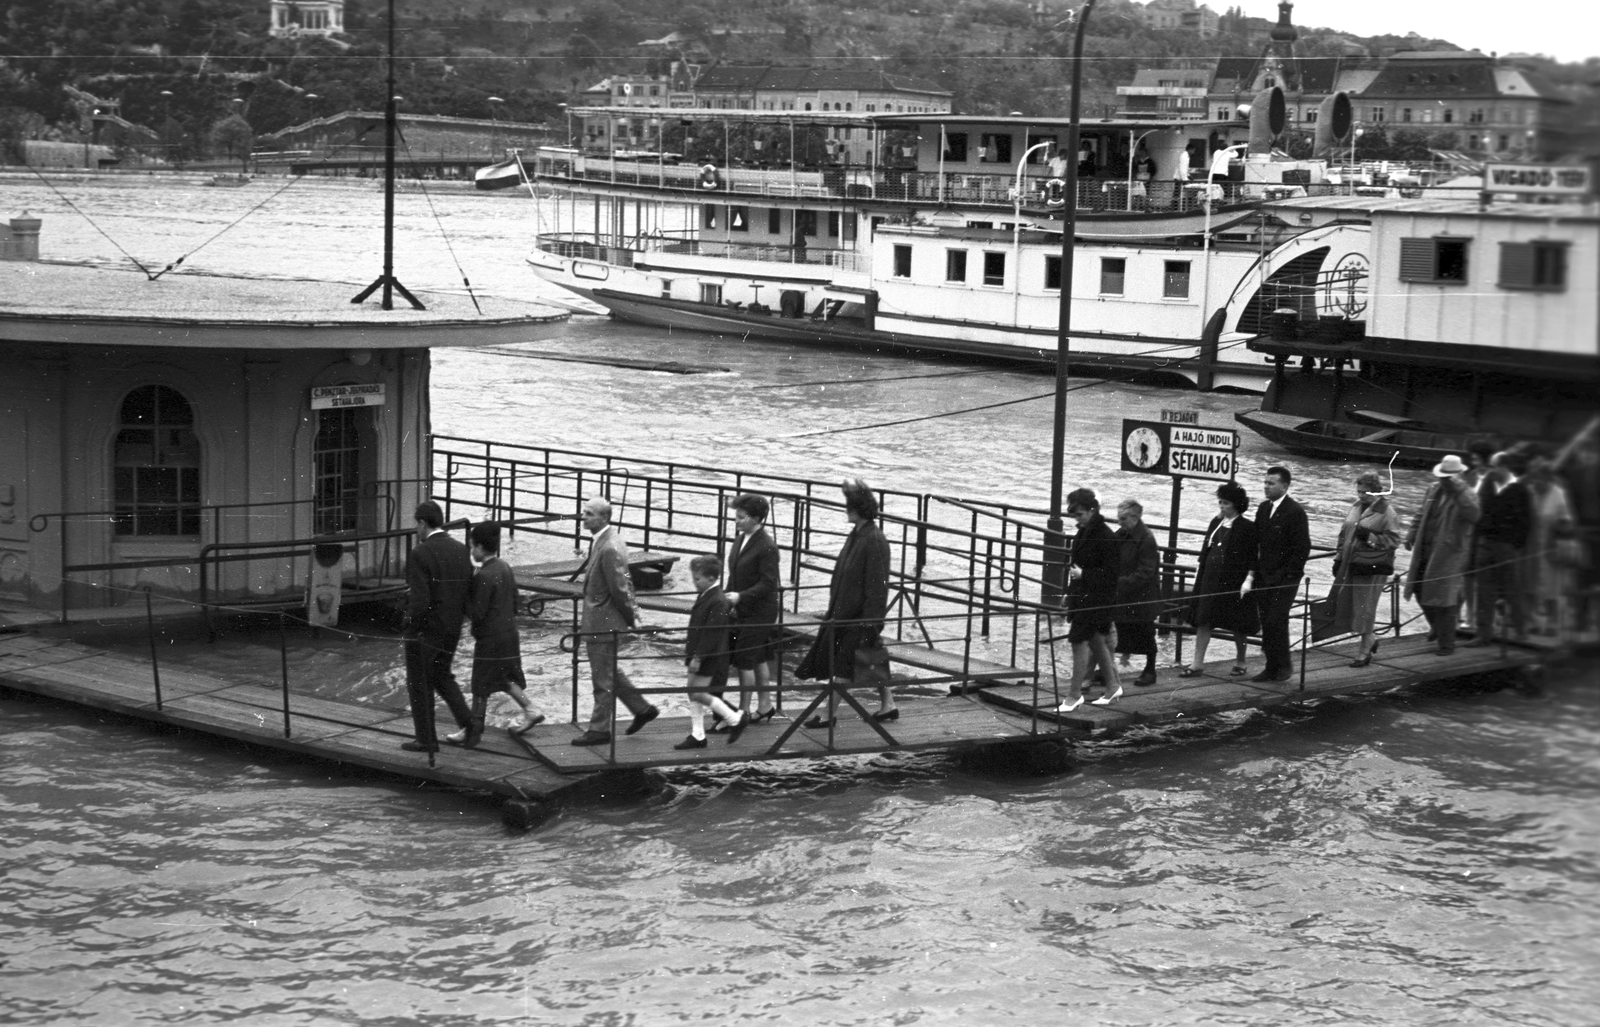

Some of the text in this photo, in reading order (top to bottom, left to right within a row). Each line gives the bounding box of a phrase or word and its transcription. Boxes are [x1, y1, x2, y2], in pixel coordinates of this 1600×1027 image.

[1174, 431, 1232, 446] A HAJÓ INDUL
[1171, 449, 1230, 475] SÉTAHAJÓ
